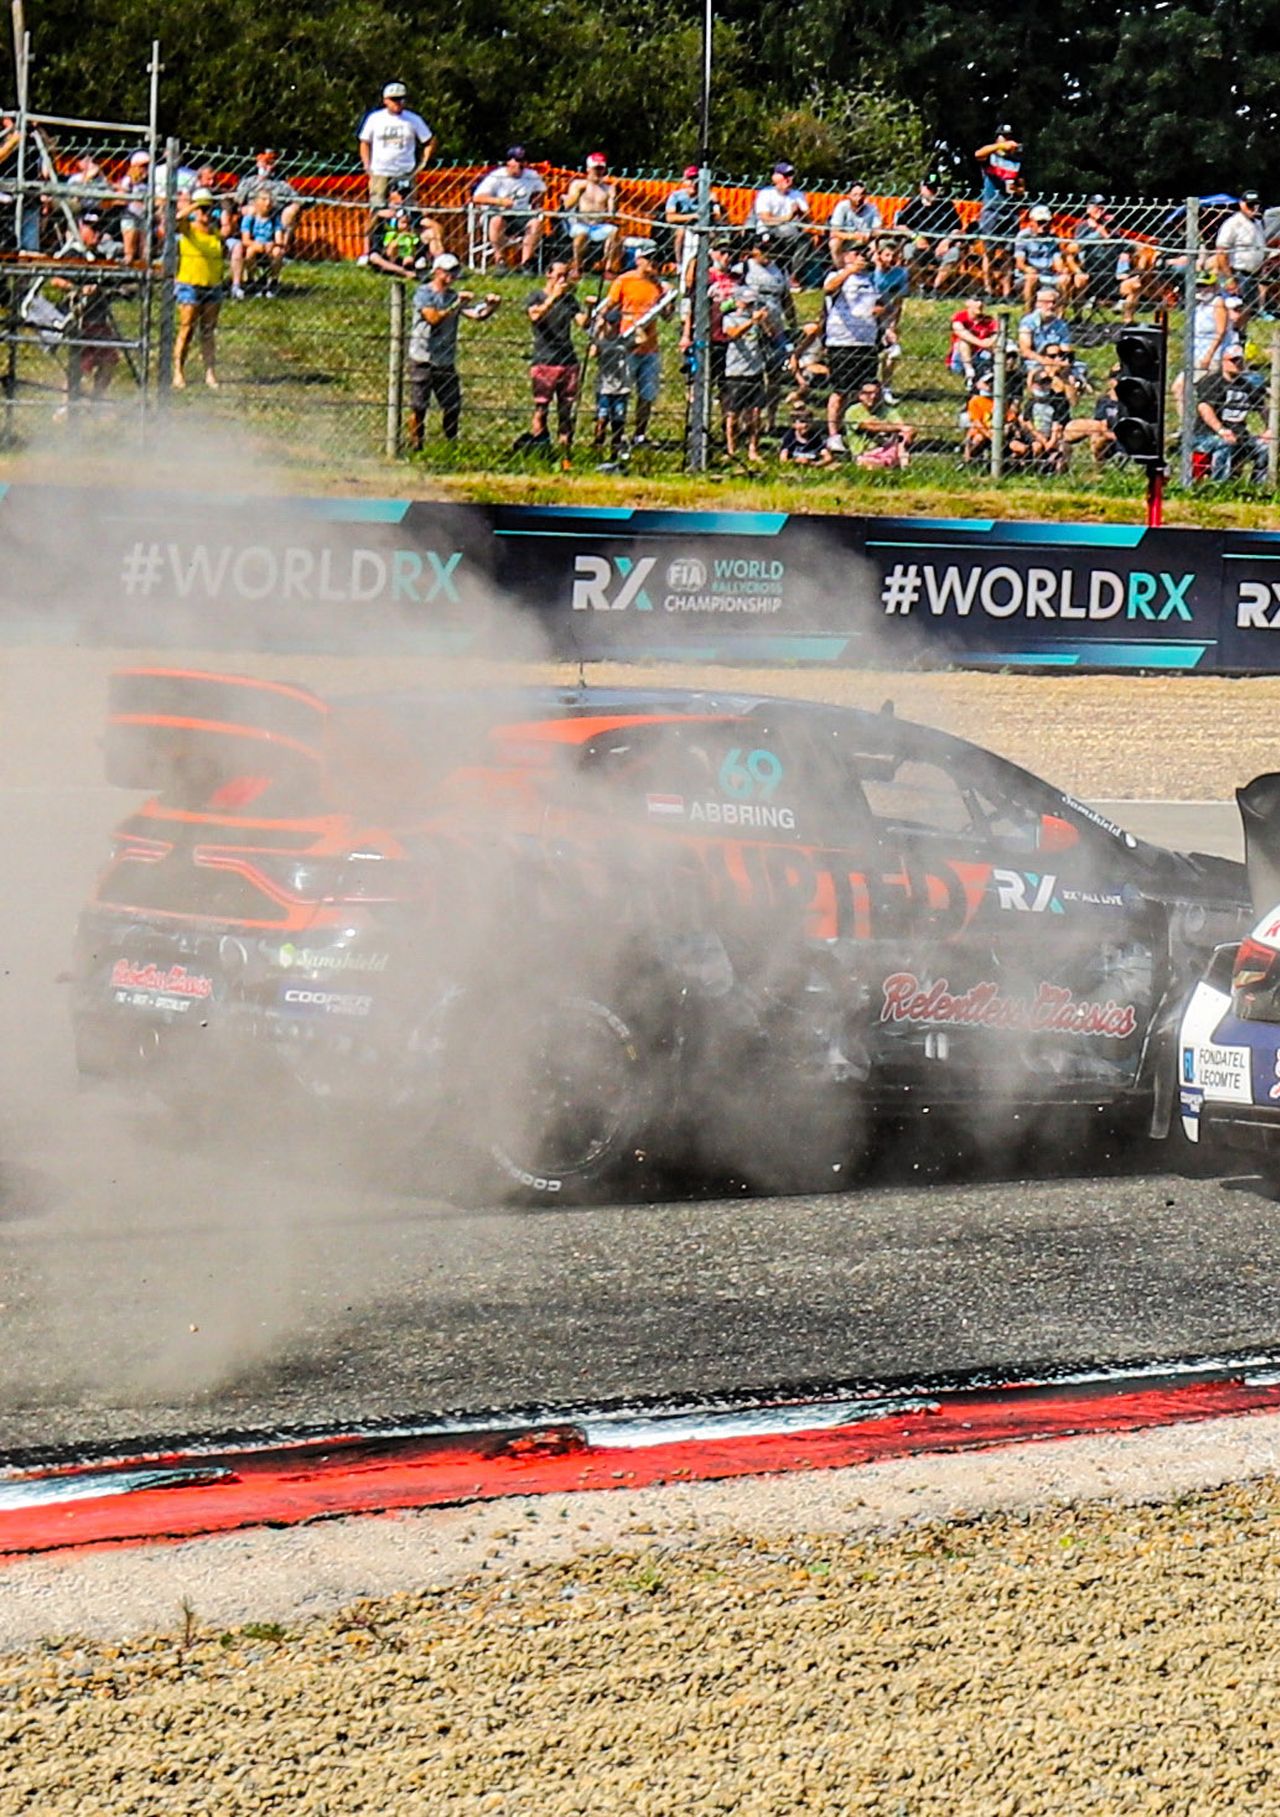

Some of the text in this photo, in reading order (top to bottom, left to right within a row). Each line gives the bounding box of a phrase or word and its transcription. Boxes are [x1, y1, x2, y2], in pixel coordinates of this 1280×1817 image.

[120, 542, 464, 603] #WORLDRX
[573, 555, 657, 612] RX
[713, 559, 784, 580] WORLD
[664, 594, 783, 615] CHAMPIONSHIP
[881, 562, 1196, 622] #WORLDRX
[718, 748, 783, 799] 69
[689, 801, 796, 829] ABBRING
[993, 869, 1065, 914] RX
[1199, 1048, 1245, 1069] FONDATEL
[1199, 1068, 1241, 1089] LECOMTE
